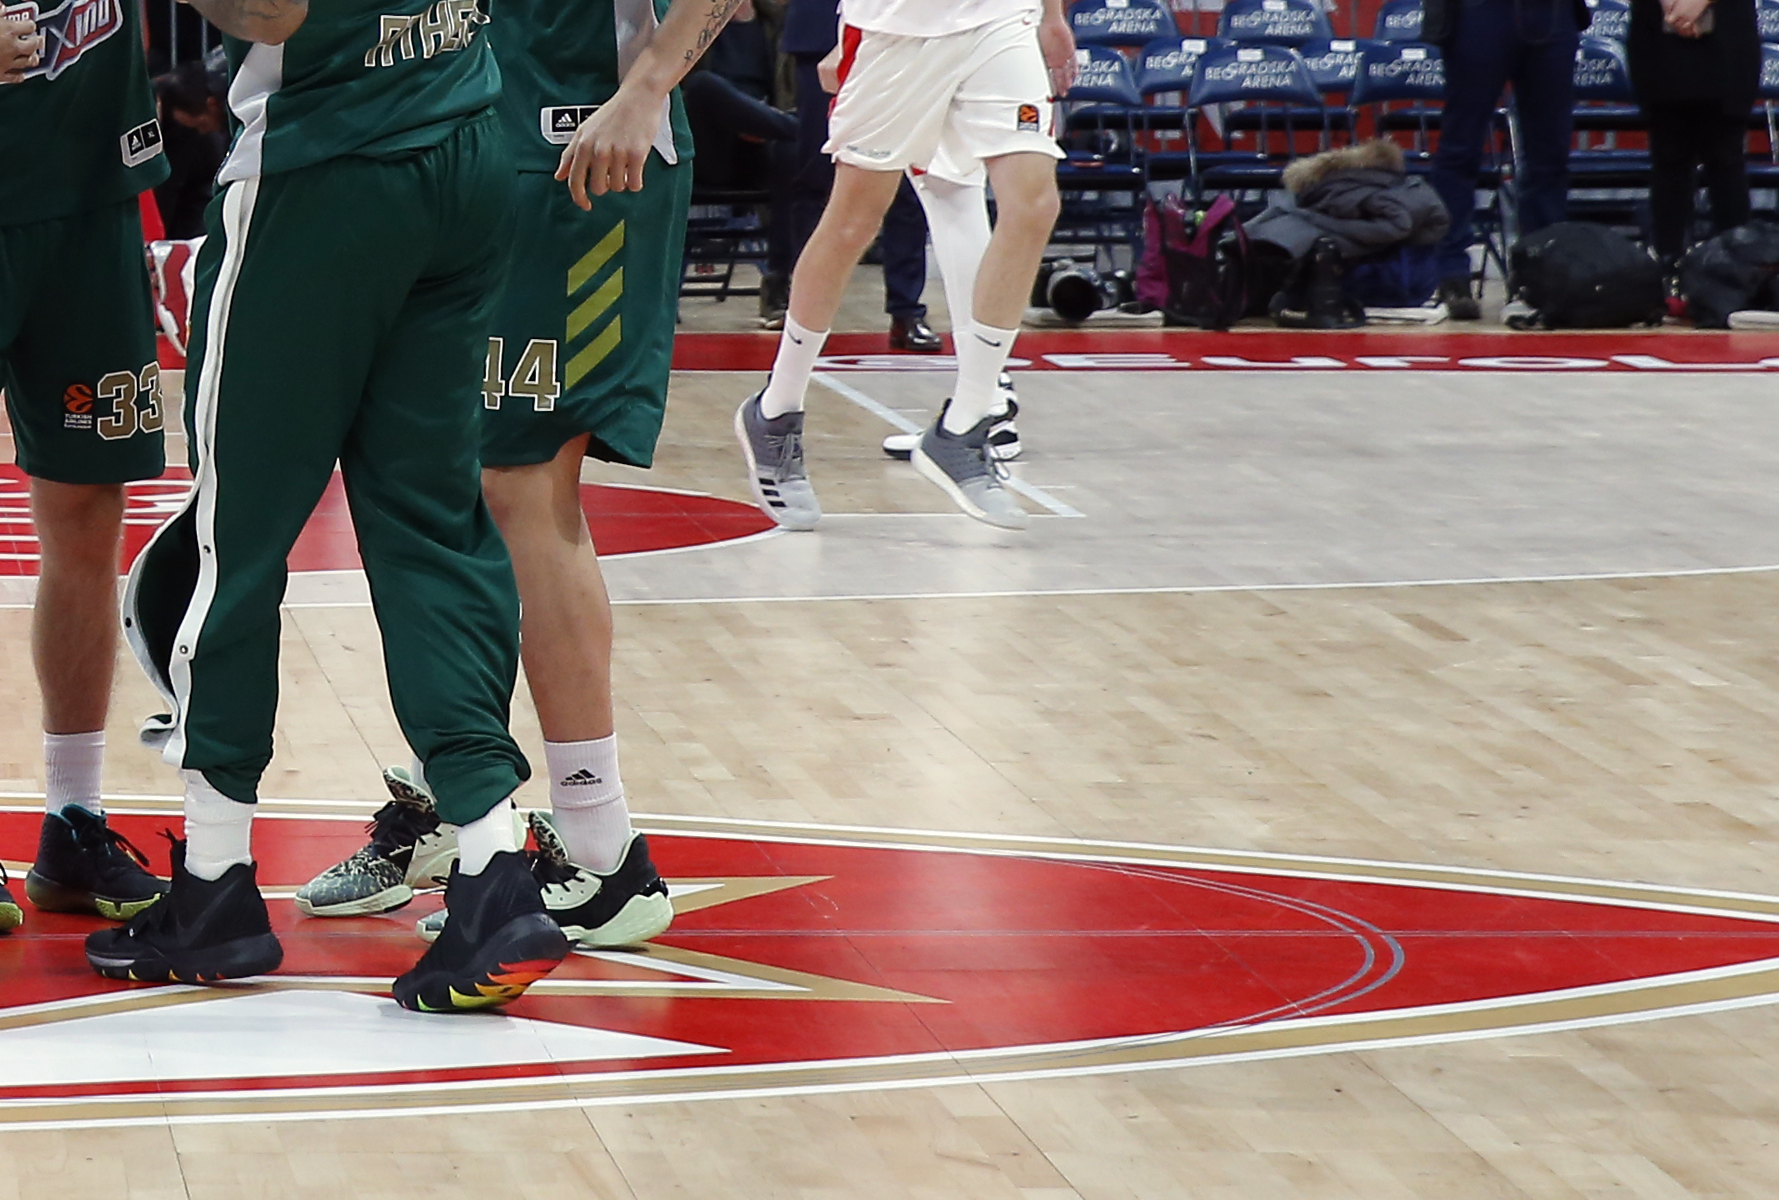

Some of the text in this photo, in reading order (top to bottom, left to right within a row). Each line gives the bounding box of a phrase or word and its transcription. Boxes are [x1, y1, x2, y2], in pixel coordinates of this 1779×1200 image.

[1072, 72, 1115, 88] RENA
[97, 361, 164, 441] 33
[560, 778, 602, 787] adidas
